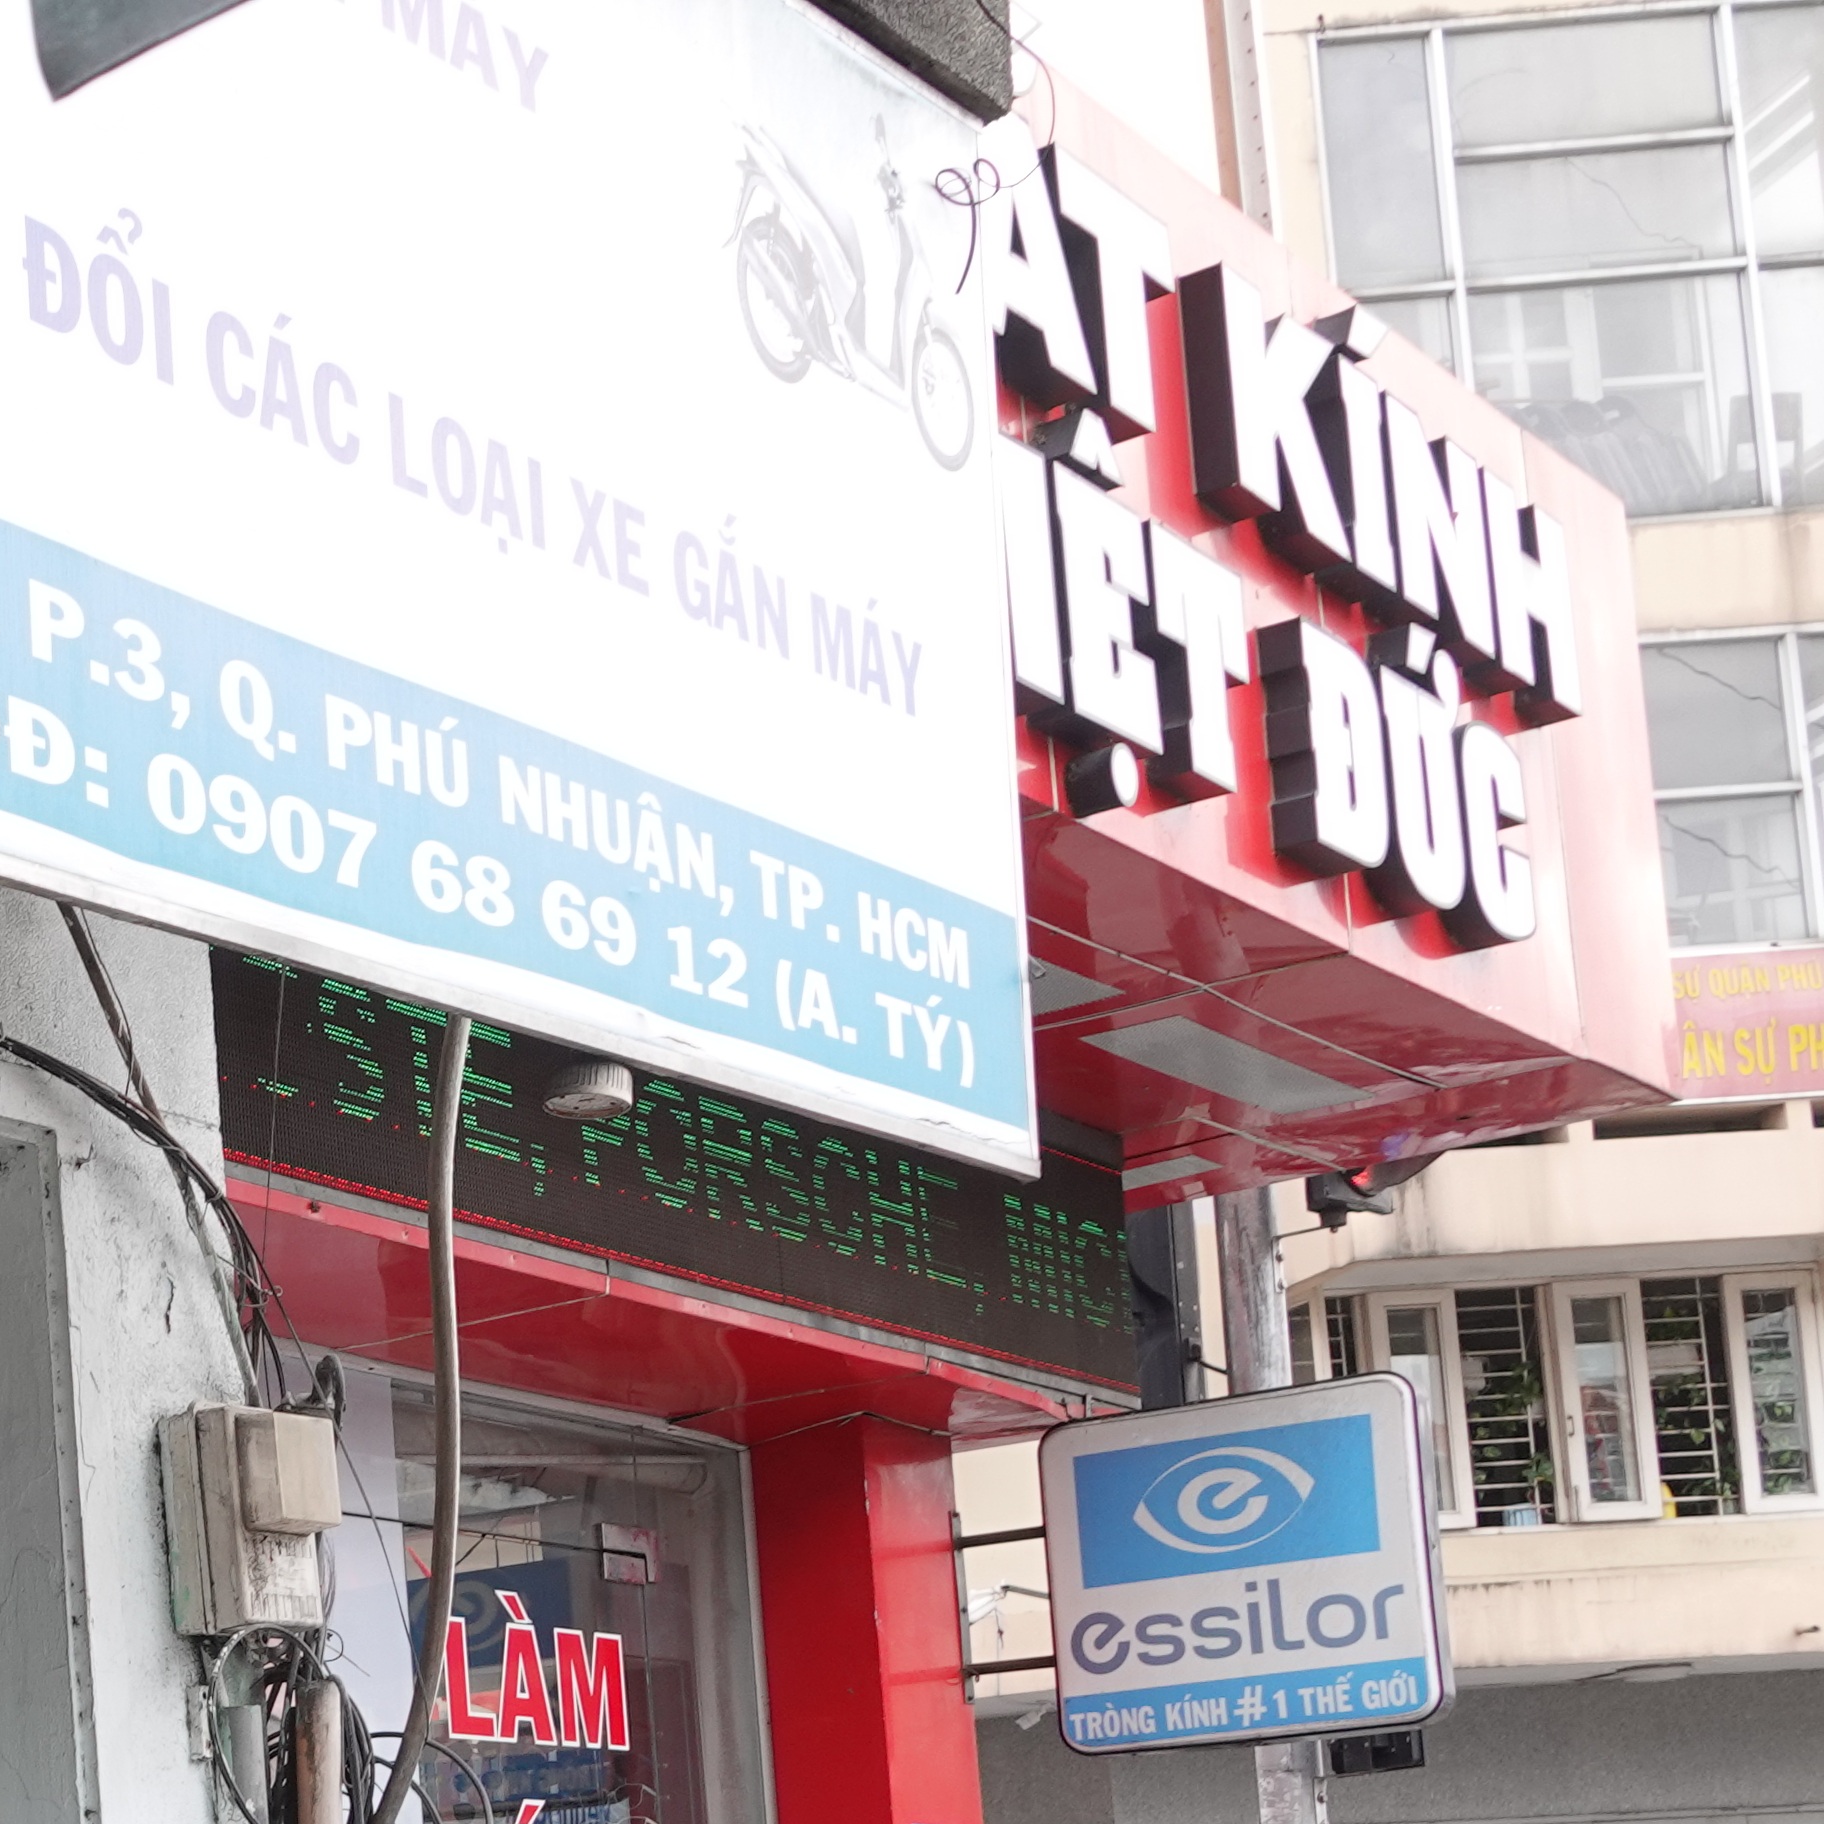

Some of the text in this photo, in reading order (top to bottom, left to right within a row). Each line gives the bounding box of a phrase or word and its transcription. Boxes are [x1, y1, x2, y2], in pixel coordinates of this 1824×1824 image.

[21, 207, 175, 388] ĐỔI
[204, 312, 361, 466] CÁC
[387, 391, 548, 560] LOẠI
[568, 476, 651, 597] XE
[674, 514, 791, 664] GẮN
[810, 598, 923, 719] MÁY
[1202, 262, 1582, 716] KÍNH
[29, 587, 191, 732] P.3,
[218, 657, 296, 756] Q.
[325, 694, 471, 808] PHÚ
[500, 758, 732, 918] NHUẬN,
[750, 850, 841, 946] TP.
[857, 891, 971, 990] HCM
[992, 407, 1538, 941] IỆT ĐỨC
[145, 749, 372, 893] 0907
[413, 851, 513, 929] 68
[541, 882, 638, 966] 69
[667, 926, 750, 1009] 12
[776, 956, 858, 1044] (A.
[875, 985, 977, 1089] TÝ)
[1681, 1015, 1824, 1086] ÂN SỰ PH
[443, 1588, 630, 1752] LÀM
[1069, 1577, 1405, 1676] essilor
[1069, 1700, 1158, 1742] TRÒNG
[1165, 1693, 1229, 1733] KÍNH
[1297, 1671, 1355, 1717] THẾ
[1361, 1669, 1418, 1711] GIỚI
